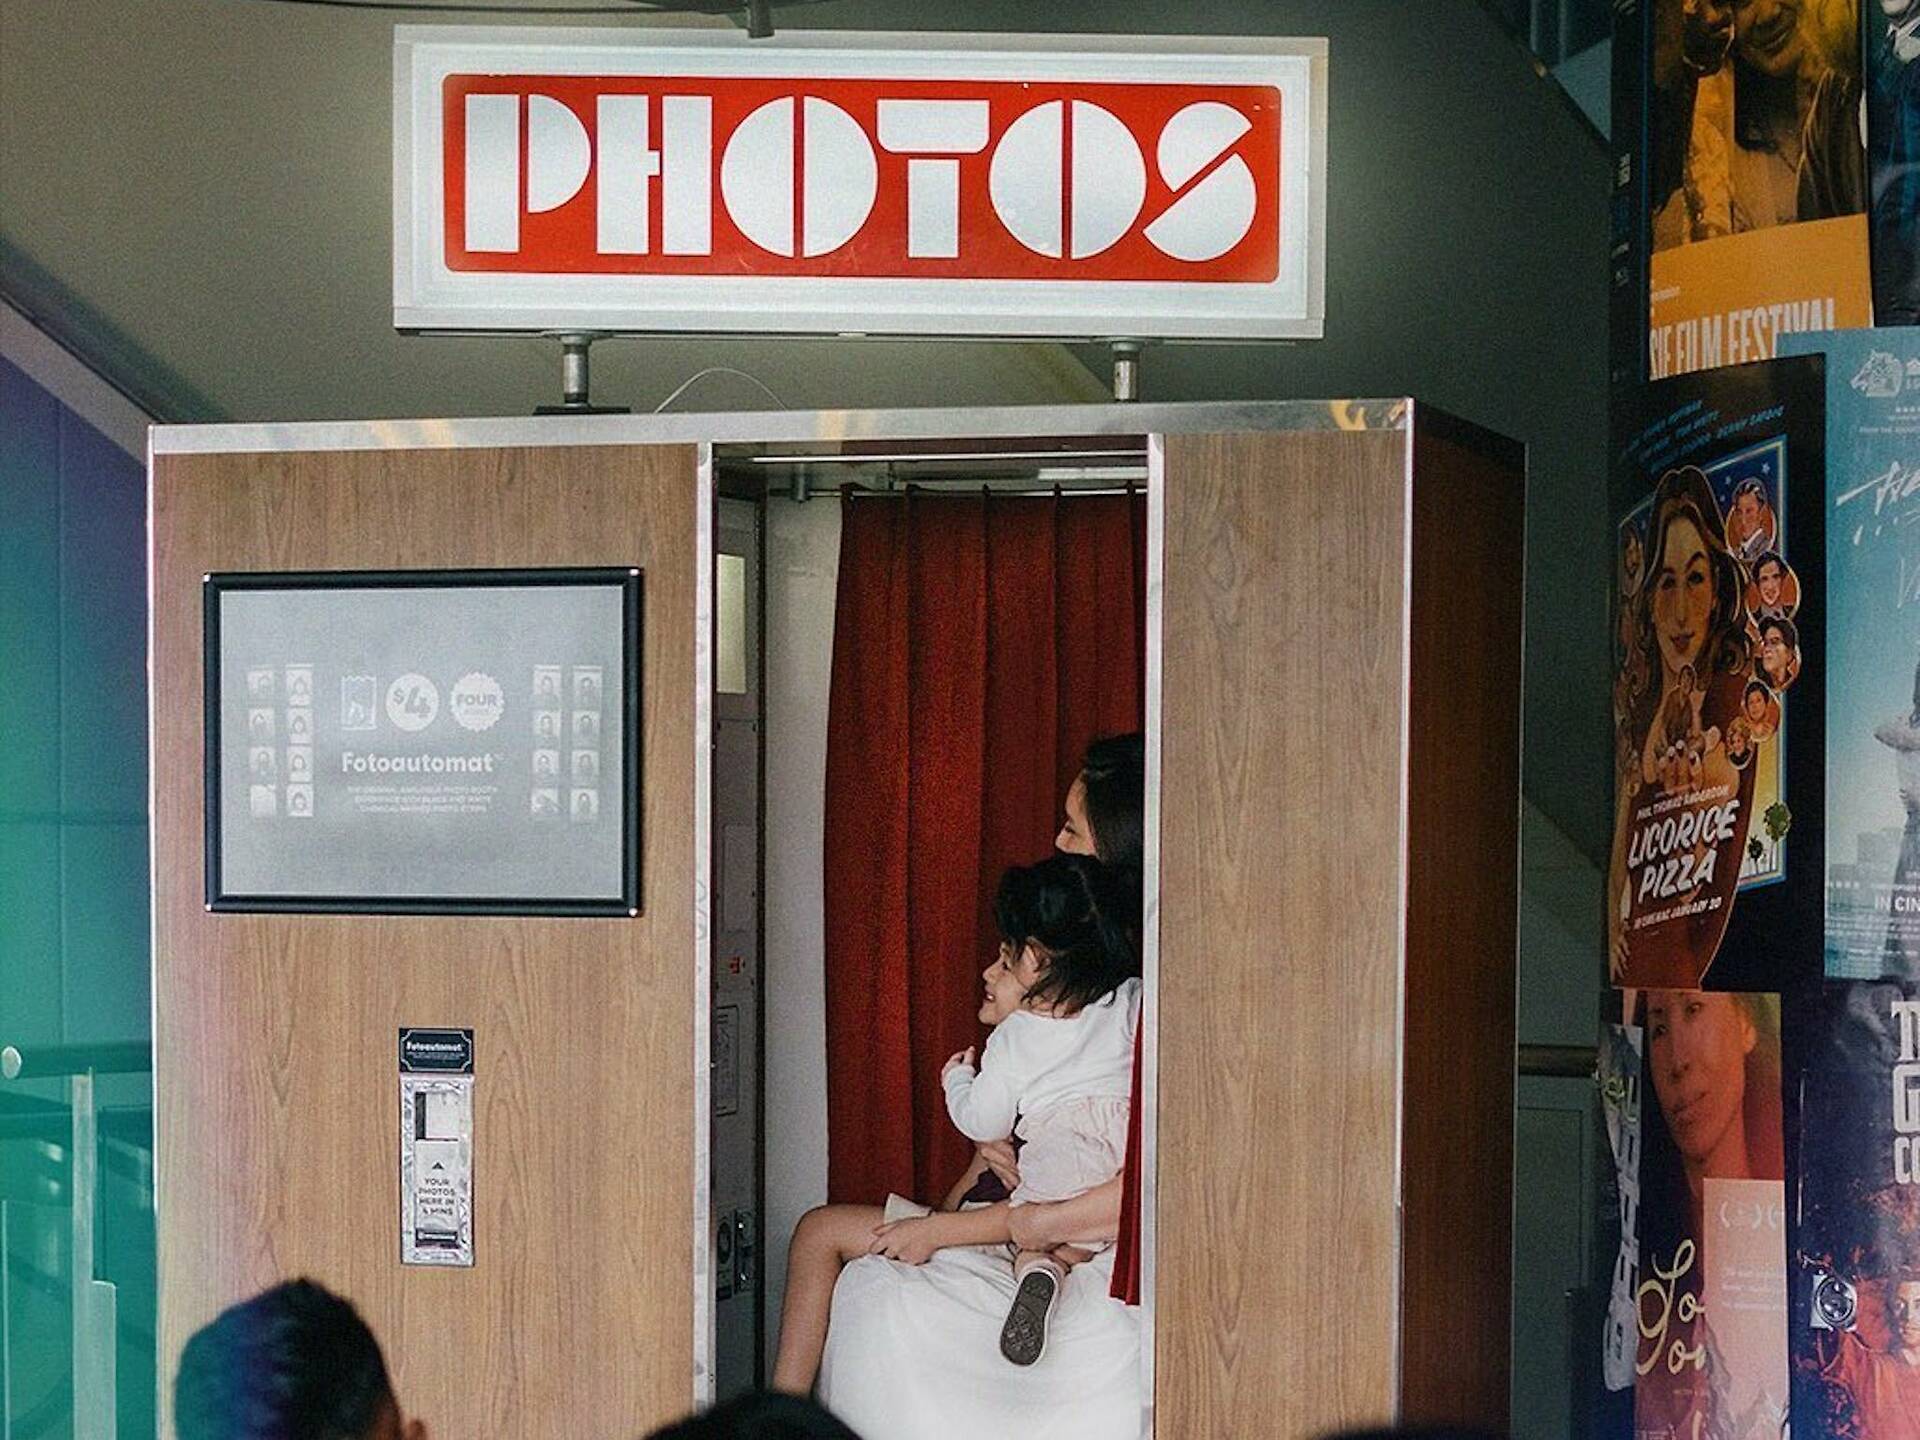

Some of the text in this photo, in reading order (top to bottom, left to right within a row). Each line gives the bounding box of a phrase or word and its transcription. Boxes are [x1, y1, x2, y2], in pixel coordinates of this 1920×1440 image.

[465, 94, 1257, 263] PHOTOS
[1674, 314, 1723, 374] FILM
[392, 686, 431, 719] $4
[456, 693, 497, 706] FOUR
[342, 752, 494, 772] Fotoautomat
[1627, 799, 1740, 869] LICORICE
[1638, 848, 1718, 904] PIZZA
[418, 1187, 456, 1196] PHOTOS
[424, 1178, 450, 1186] YOUR
[419, 1198, 442, 1206] HERE
[430, 1207, 454, 1216] MINS
